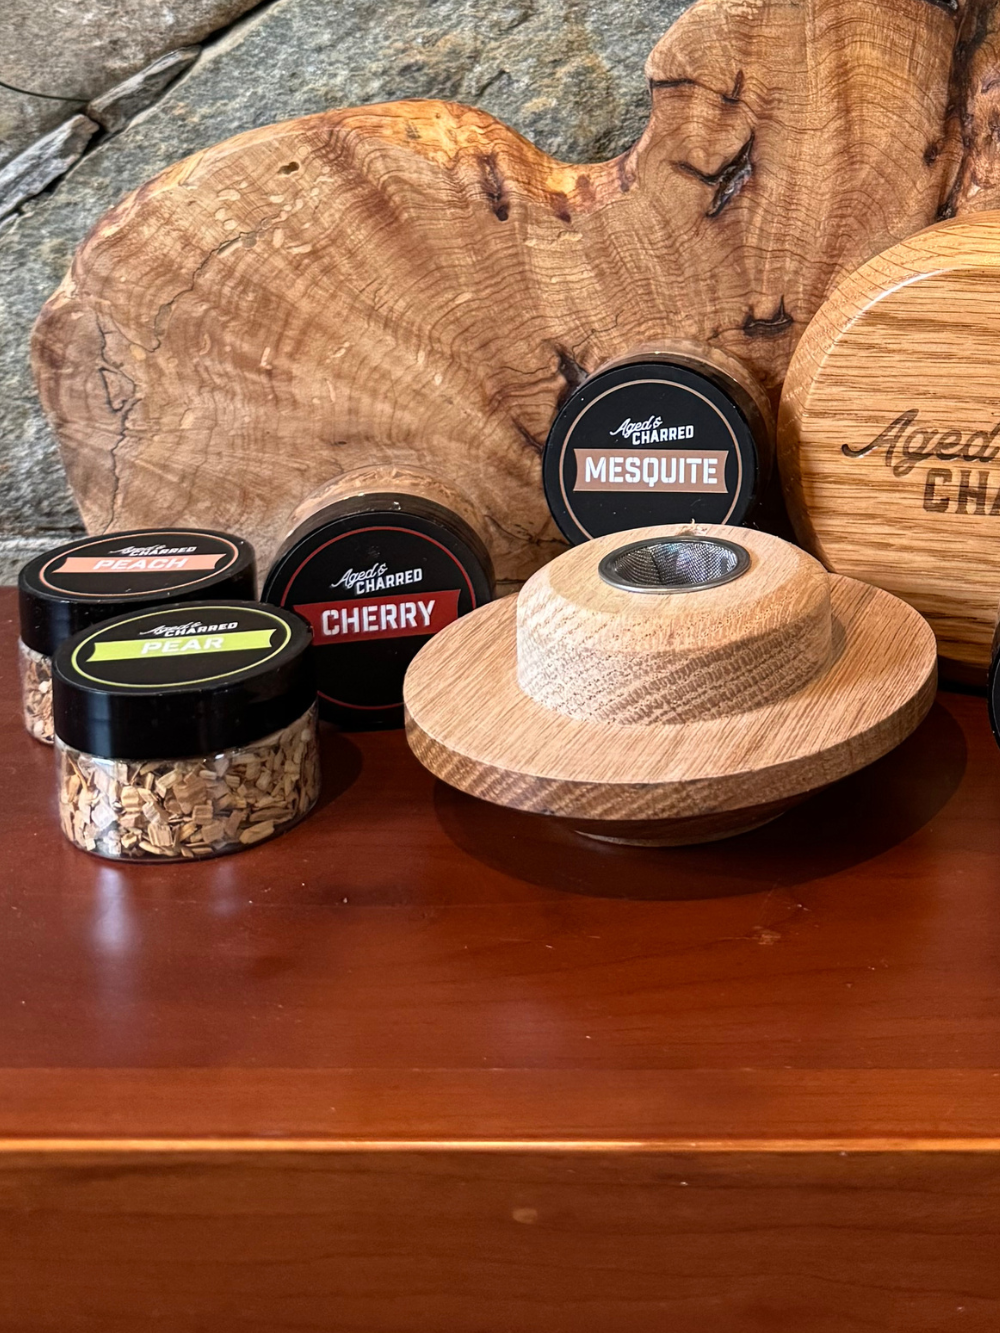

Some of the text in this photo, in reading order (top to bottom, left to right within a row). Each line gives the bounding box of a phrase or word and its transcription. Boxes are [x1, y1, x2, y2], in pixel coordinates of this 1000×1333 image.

[609, 416, 654, 439] Aged
[632, 425, 694, 445] CHARRED
[585, 456, 718, 487] MESQUITE
[129, 546, 197, 557] CHARRED
[92, 557, 189, 571] PEACH
[330, 563, 379, 589] Aged
[356, 568, 423, 595] CHARRED
[321, 600, 436, 636] CHERRY
[164, 622, 238, 637] CHARRED
[140, 637, 225, 655] PEAR
